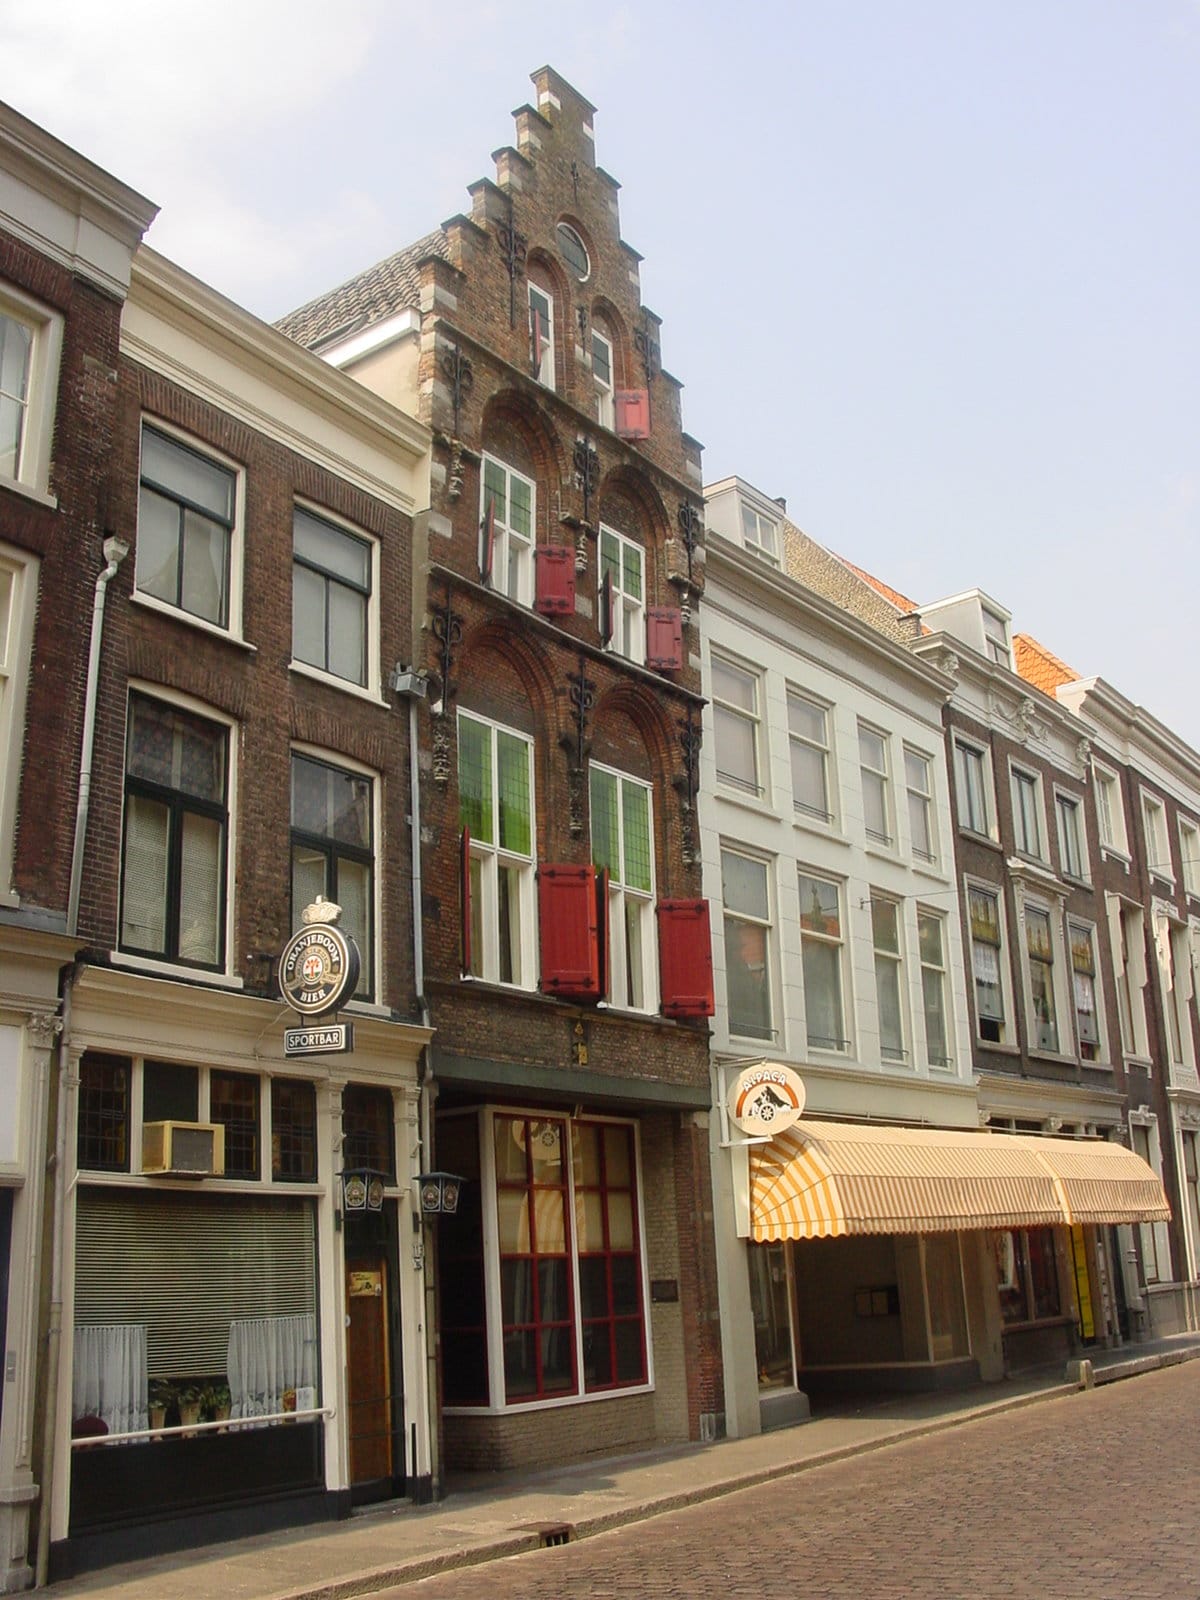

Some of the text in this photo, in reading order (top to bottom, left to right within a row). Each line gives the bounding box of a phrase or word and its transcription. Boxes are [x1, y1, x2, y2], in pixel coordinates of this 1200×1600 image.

[287, 934, 339, 971] ORANJEBOOM
[300, 989, 326, 1003] BIER
[289, 1032, 339, 1047] SPORTBAR
[743, 1070, 787, 1092] ALPACA
